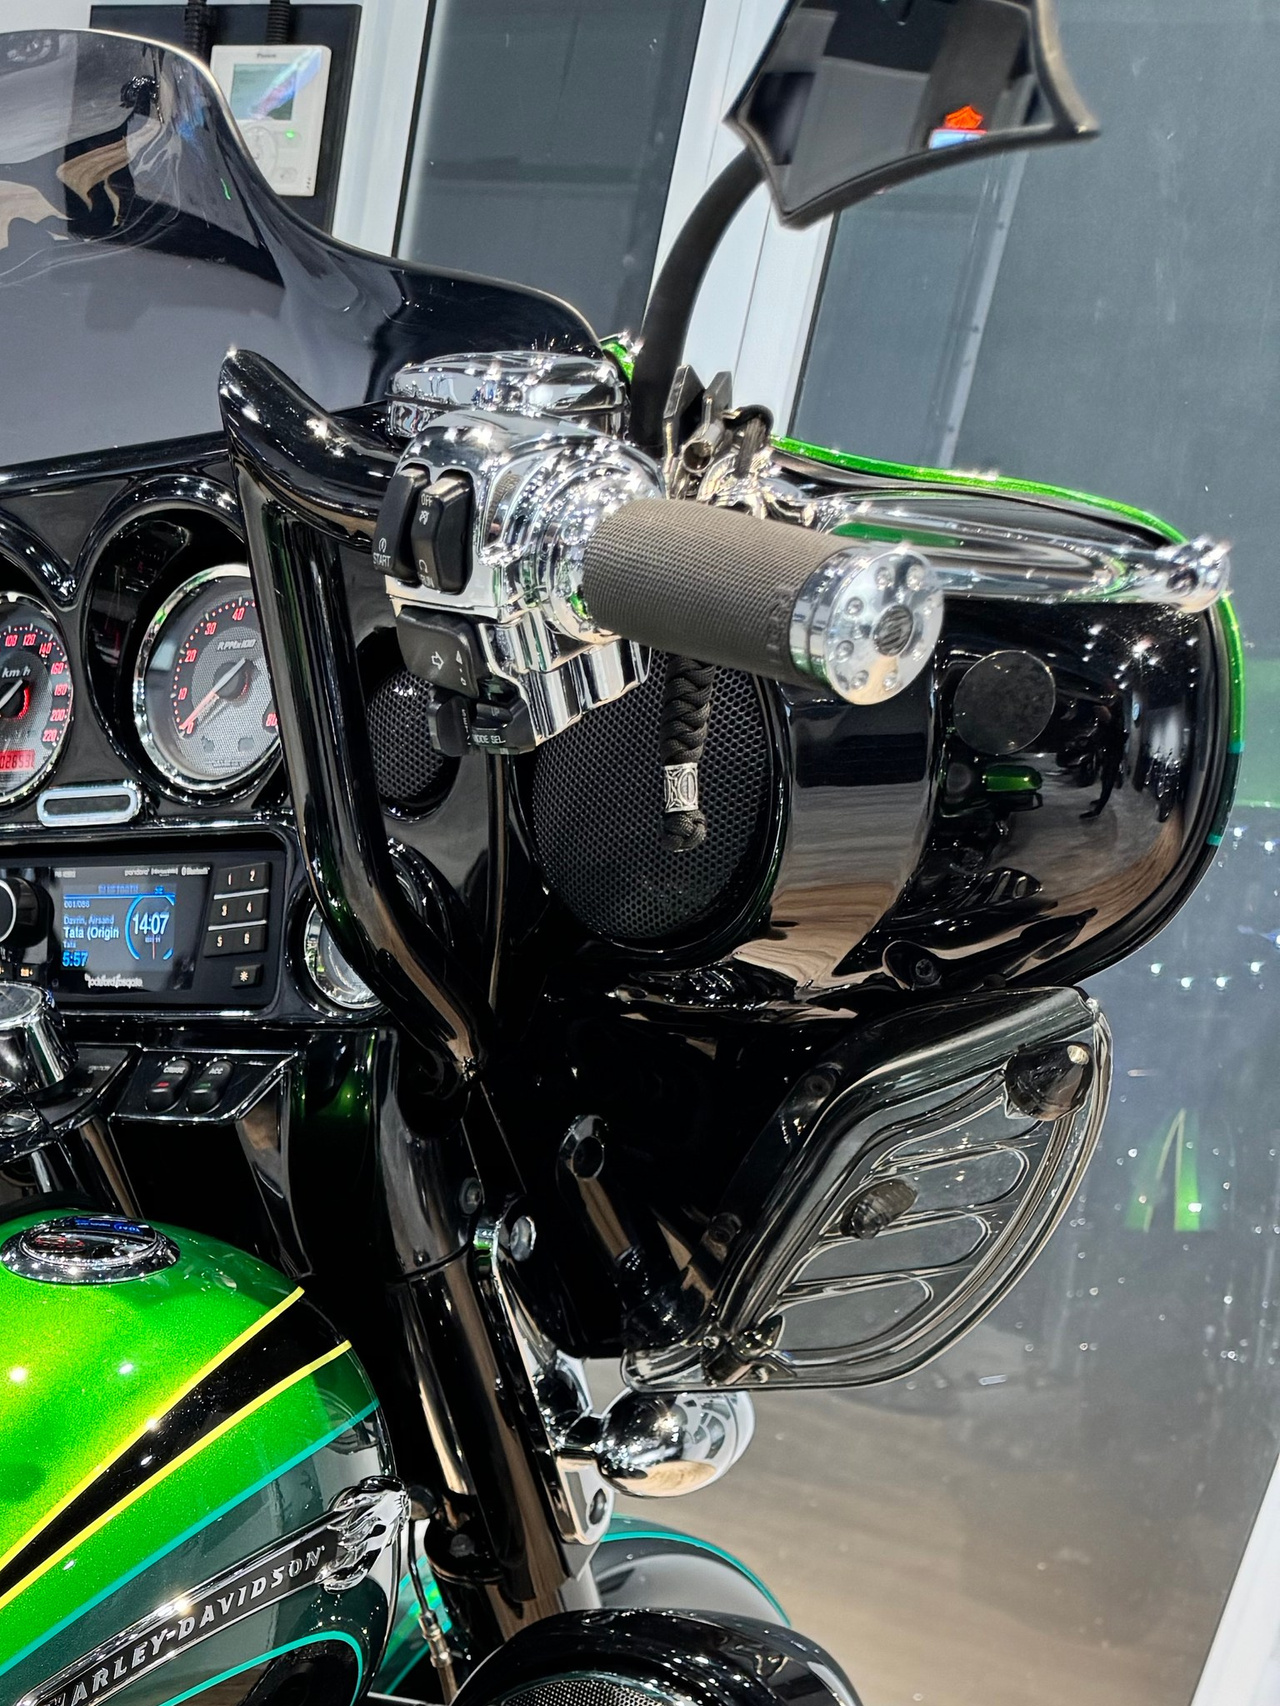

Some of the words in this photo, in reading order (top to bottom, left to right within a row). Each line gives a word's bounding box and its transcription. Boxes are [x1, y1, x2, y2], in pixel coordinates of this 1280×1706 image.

[421, 493, 433, 507] OFF
[373, 552, 391, 567] START
[232, 607, 245, 622] 40
[204, 621, 218, 636] 30
[5, 633, 18, 647] 100
[22, 633, 36, 646] 120
[185, 650, 197, 663] 20
[51, 661, 64, 675] 160
[54, 683, 67, 696] 180
[178, 687, 188, 700] 10
[51, 708, 65, 721] 200
[42, 729, 57, 742] 220
[132, 911, 170, 935] 14:07
[63, 926, 84, 939] Tata
[86, 926, 119, 941] (Origin
[62, 951, 89, 967] 5:57
